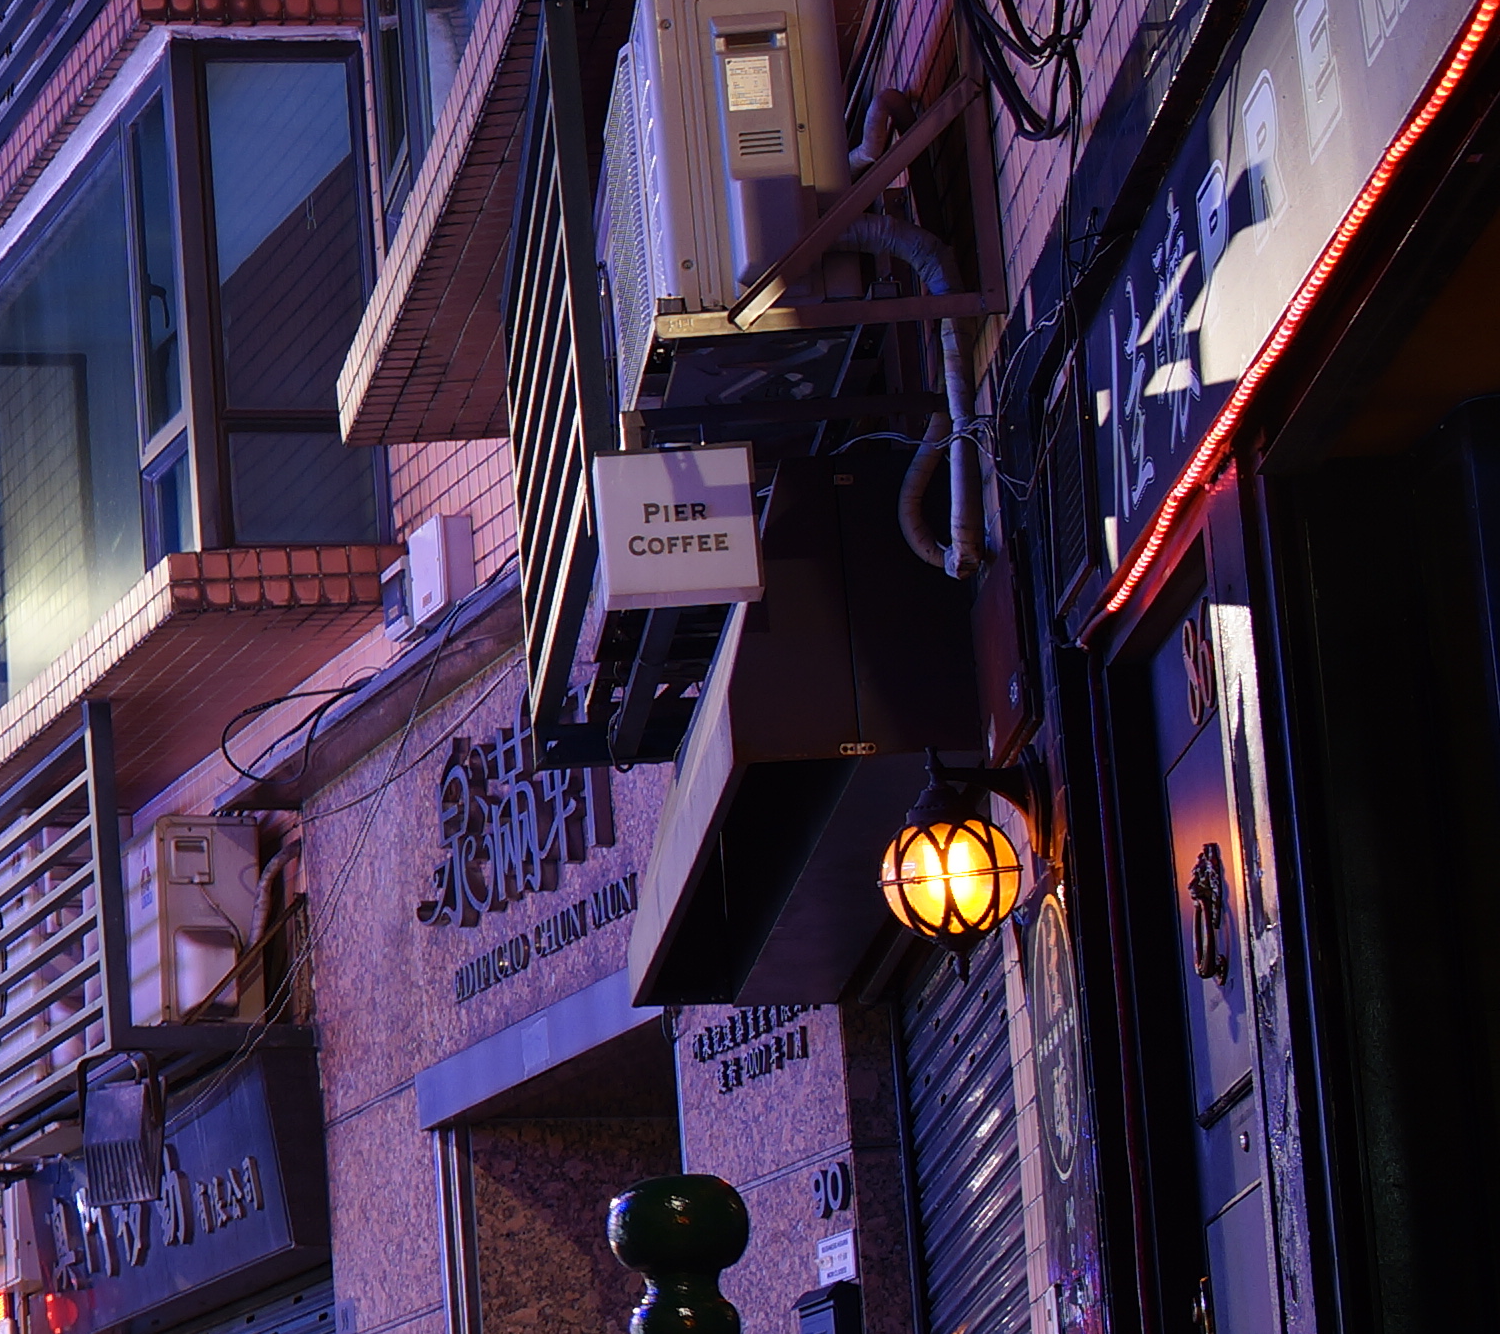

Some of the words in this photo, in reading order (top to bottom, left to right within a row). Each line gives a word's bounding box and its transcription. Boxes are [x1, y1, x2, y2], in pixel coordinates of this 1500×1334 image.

[642, 501, 708, 524] PIER
[628, 532, 730, 556] COFFEE
[1182, 597, 1216, 727] 86
[454, 932, 530, 1004] EDIFICIO
[534, 898, 587, 958] CHUN
[591, 871, 639, 929] MUN
[810, 1162, 844, 1218] 90
